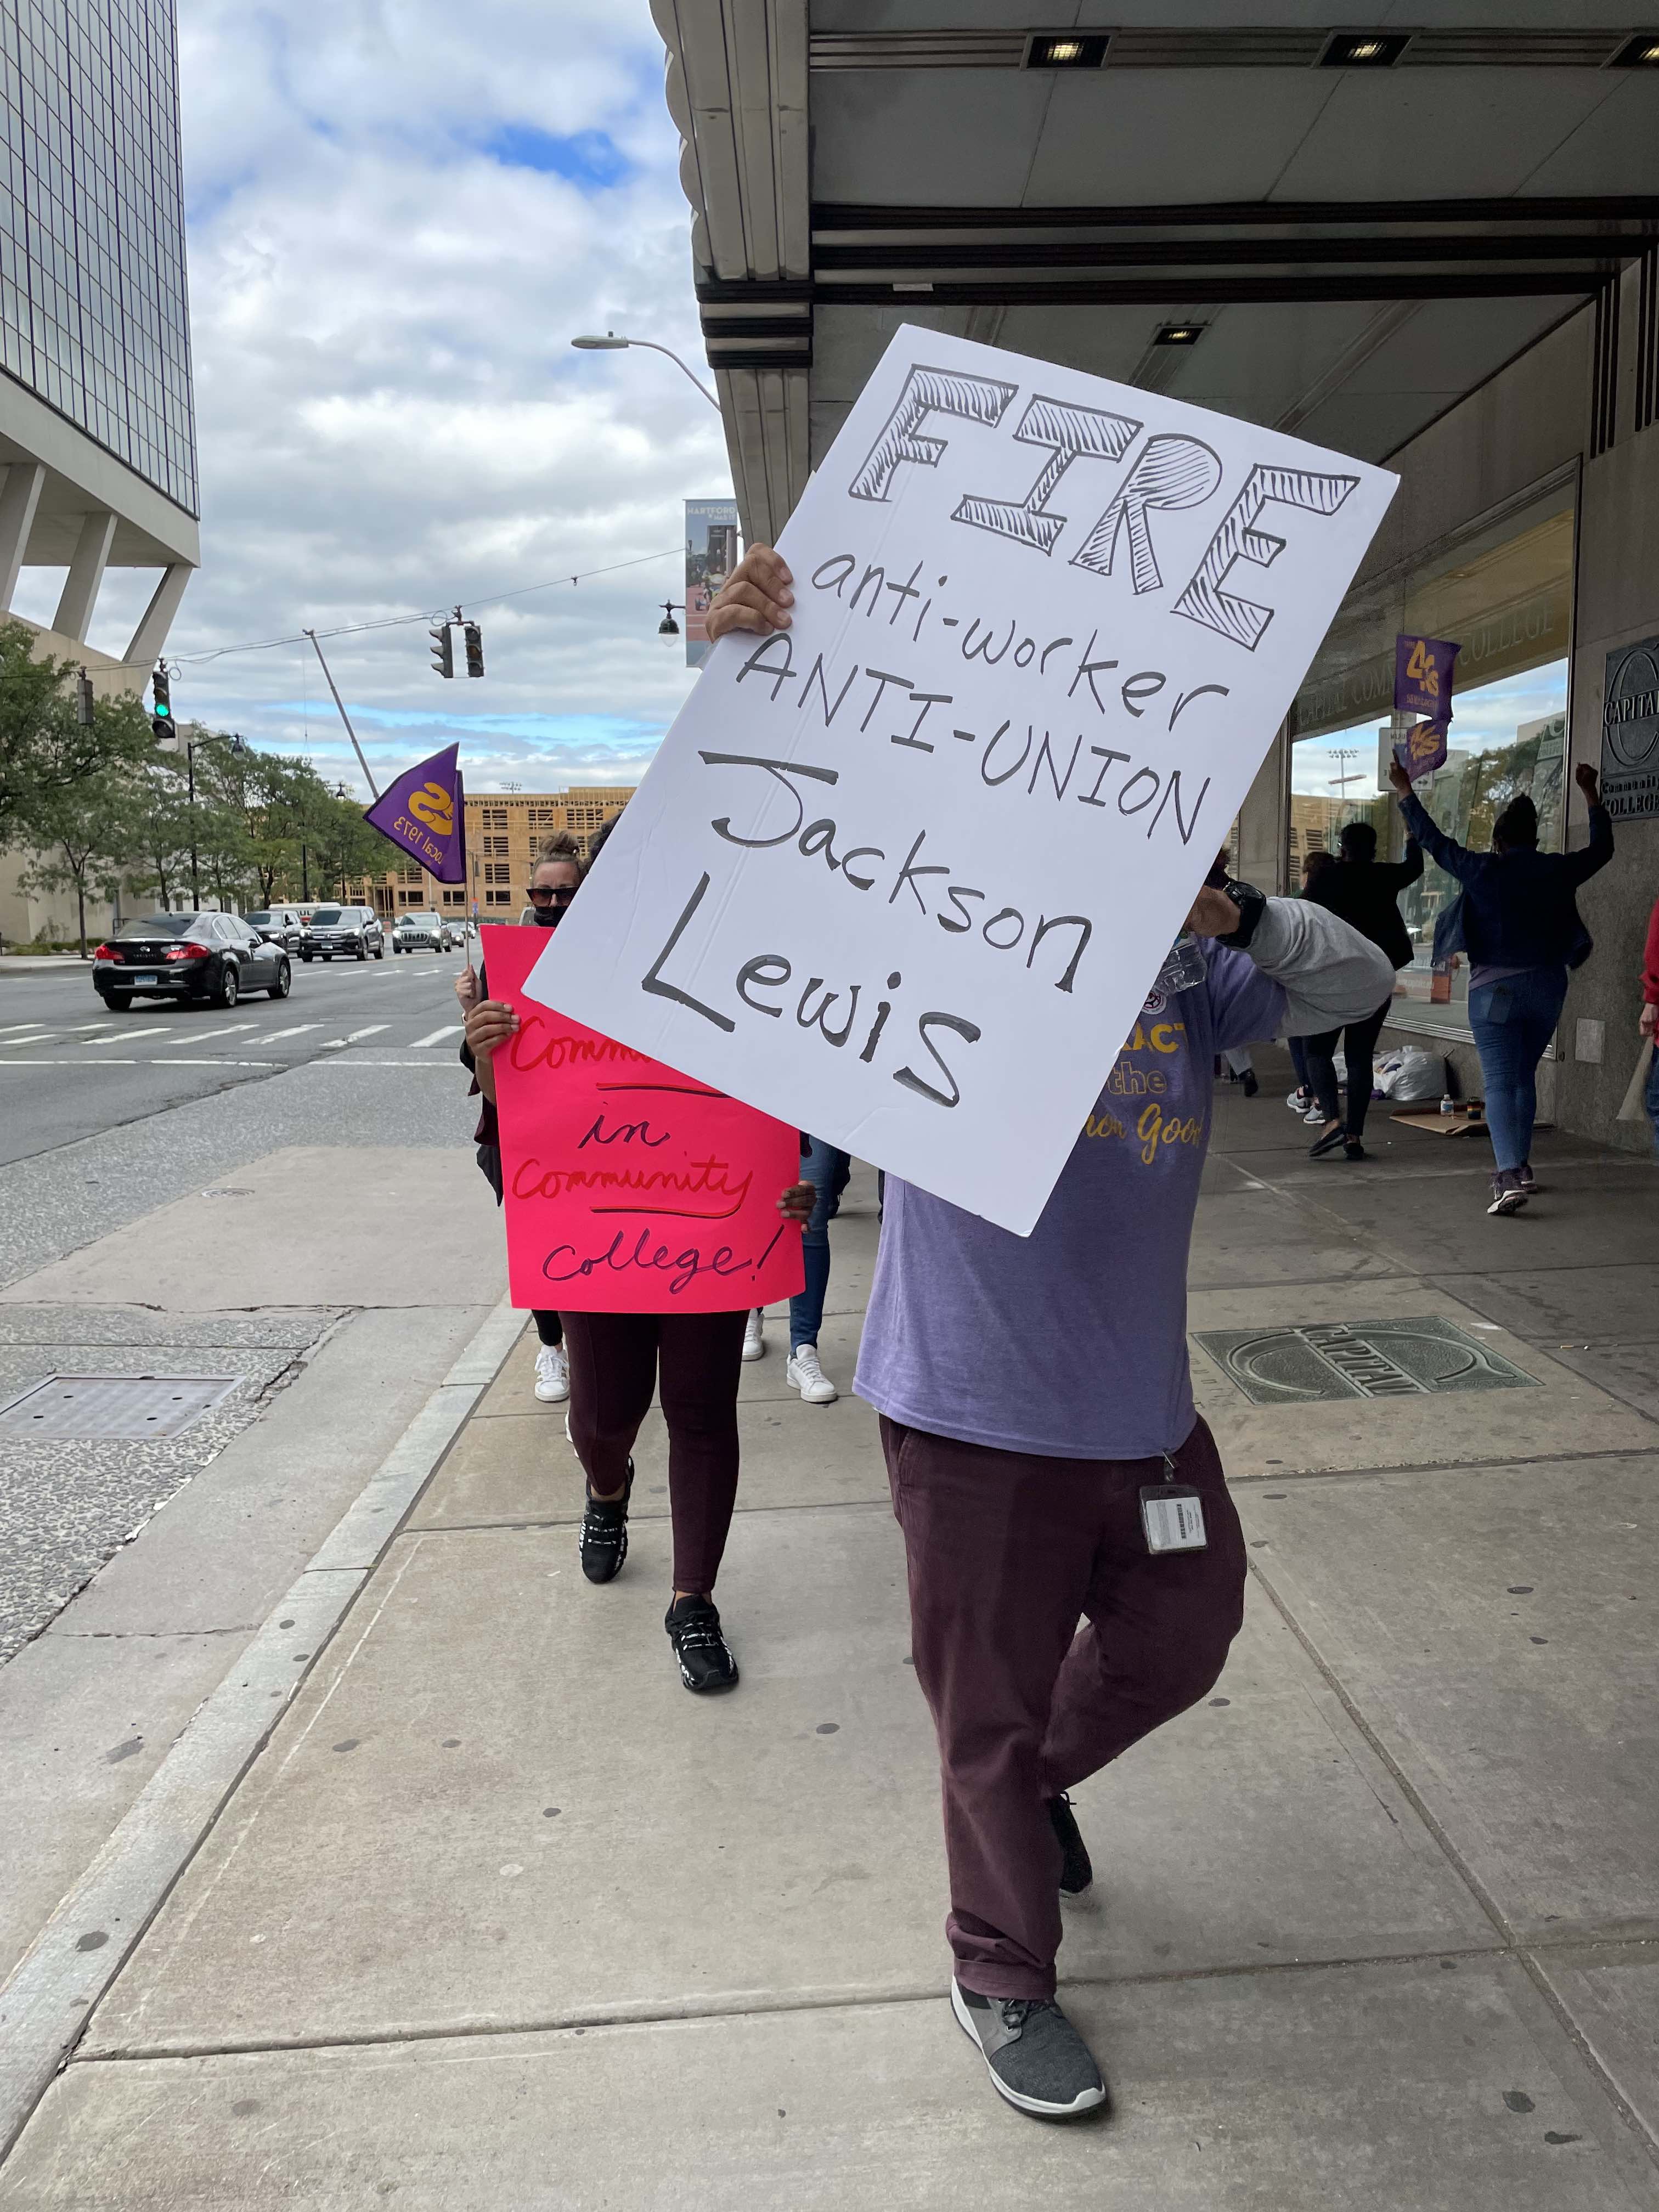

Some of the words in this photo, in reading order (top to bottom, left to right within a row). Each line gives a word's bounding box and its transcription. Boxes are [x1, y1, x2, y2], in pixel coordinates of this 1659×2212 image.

[848, 364, 1361, 652] FIRE
[812, 554, 1230, 732] anti-worker
[736, 634, 1211, 846] ANTI-UNION
[698, 751, 1092, 993] Jackson
[510, 1015, 661, 1071] Comm
[1121, 1022, 1189, 1053] ACT
[1108, 1061, 1167, 1094] the
[578, 1102, 670, 1149] in
[1299, 1325, 1422, 1396] CAPITAL
